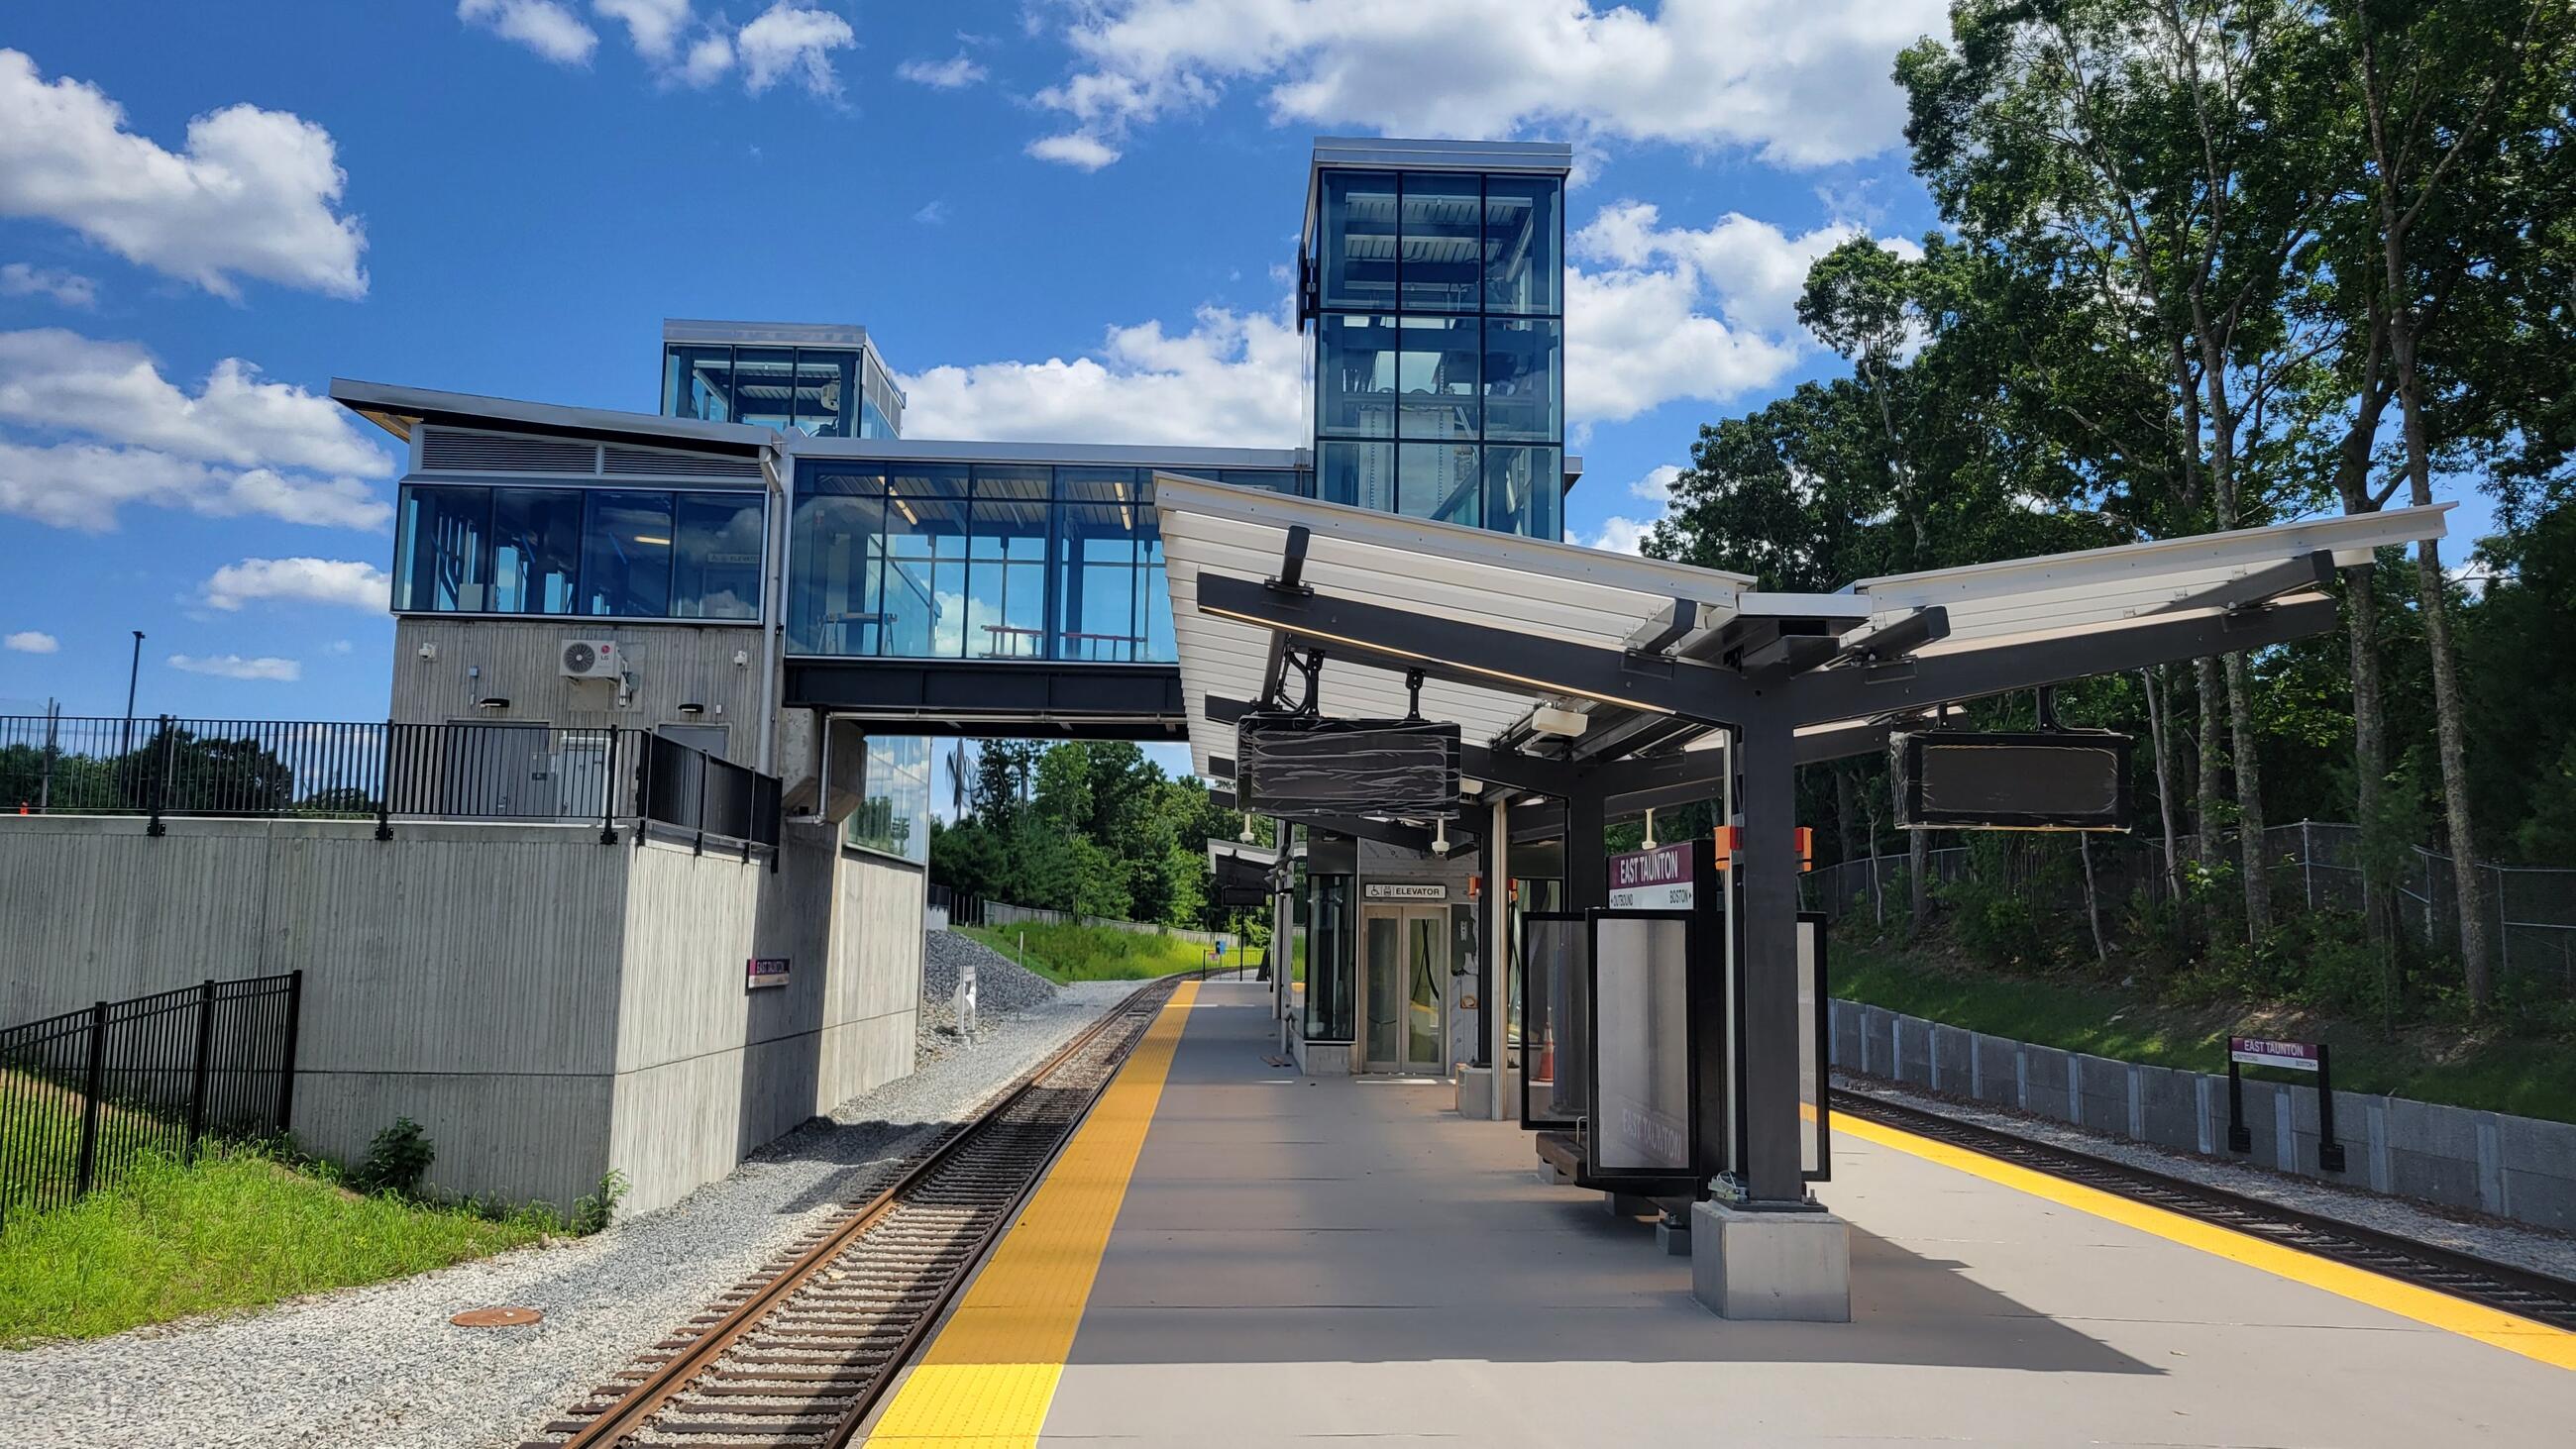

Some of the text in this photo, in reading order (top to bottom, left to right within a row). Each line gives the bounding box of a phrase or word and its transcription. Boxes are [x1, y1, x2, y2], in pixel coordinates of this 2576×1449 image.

[1620, 851, 1678, 884] EAST TAUNTON
[1396, 887, 1440, 896] ELEVATOR
[1669, 888, 1689, 904] BOSTON
[2243, 1039, 2304, 1057] EAST TAUNTON
